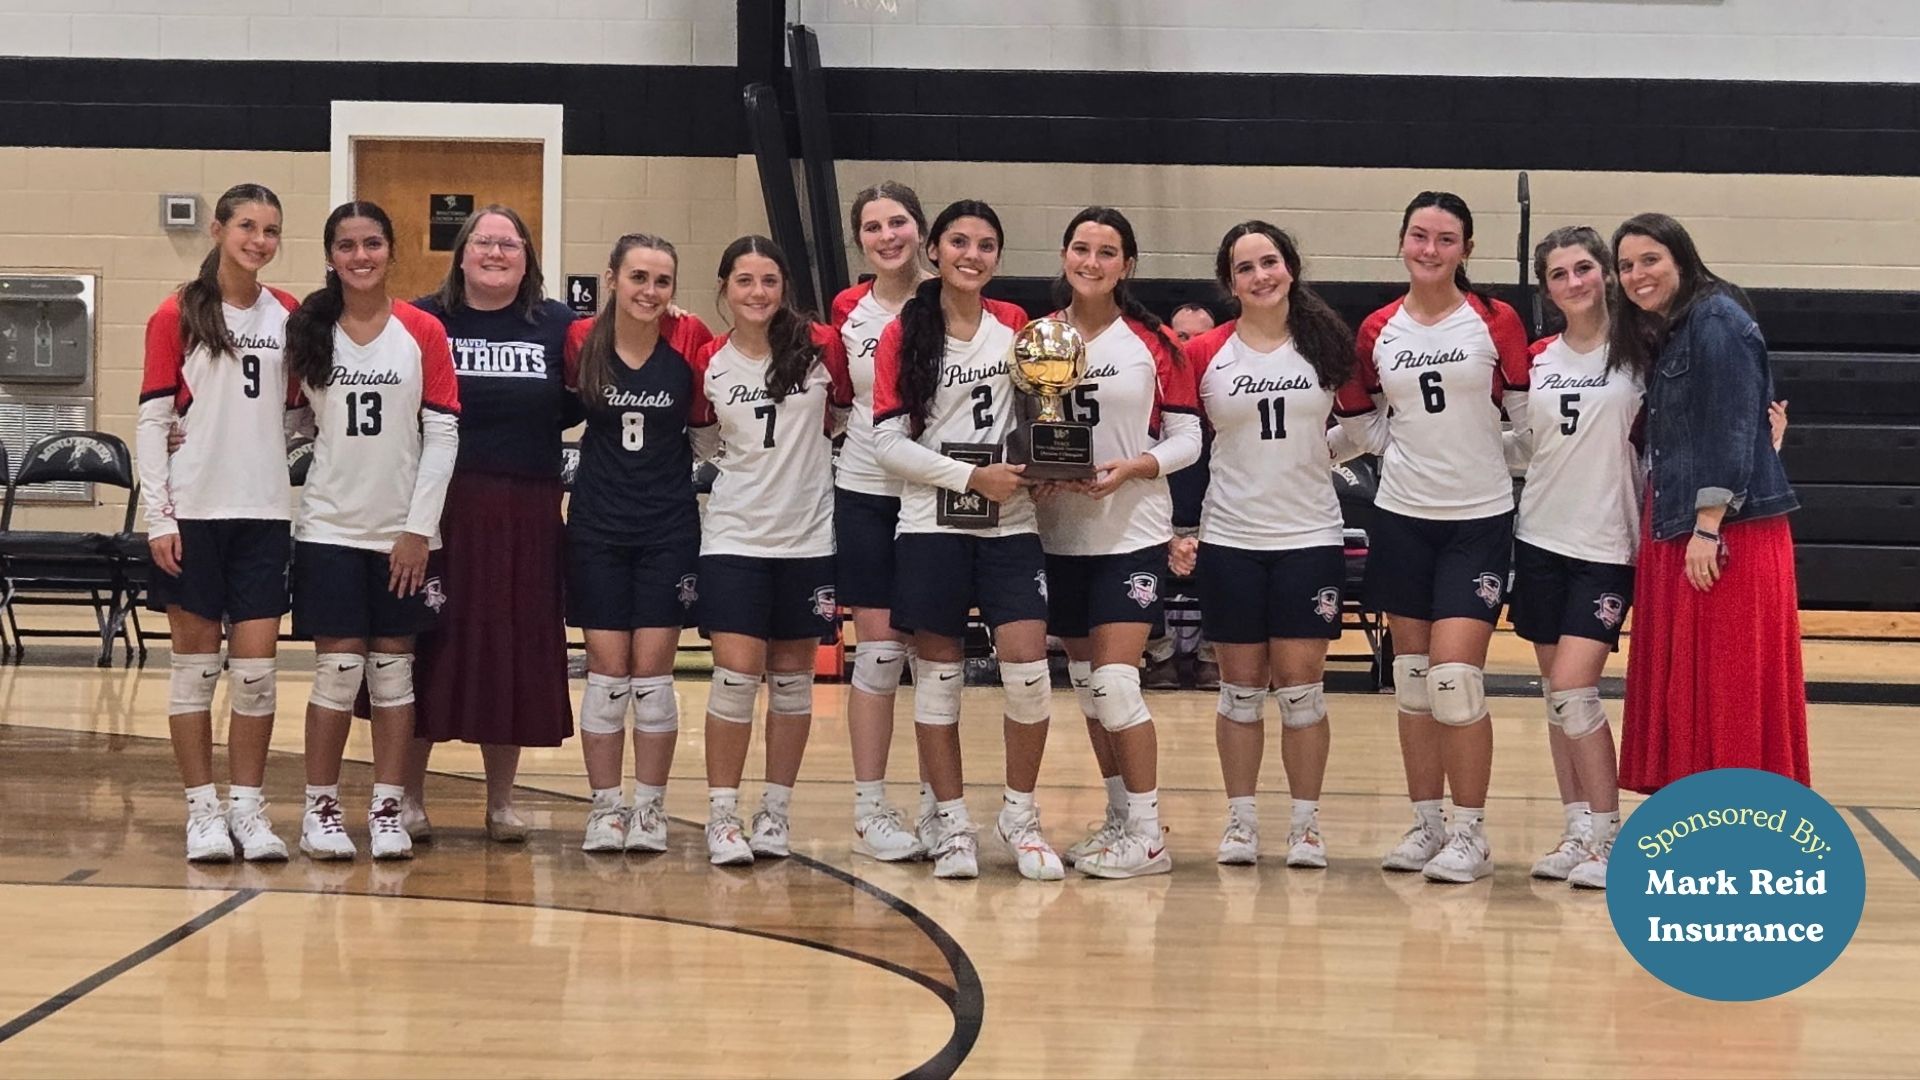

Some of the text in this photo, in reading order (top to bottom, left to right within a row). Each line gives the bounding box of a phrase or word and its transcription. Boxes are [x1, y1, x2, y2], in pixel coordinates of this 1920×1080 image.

[242, 354, 260, 399] 9
[326, 365, 402, 386] Patriots
[449, 346, 547, 373] TRIOTS
[1083, 363, 1119, 379] iots
[1390, 347, 1469, 371] Patriots
[600, 383, 674, 408] Patriots
[1228, 374, 1312, 397] Patriots
[1419, 370, 1446, 414] 6
[1536, 373, 1610, 390] Patriots
[346, 391, 382, 437] 13
[971, 384, 994, 430] 2
[1062, 383, 1100, 427] 15
[1257, 396, 1287, 440] 11
[1560, 393, 1580, 436] 5
[621, 411, 645, 452] 8
[754, 405, 777, 449] 7
